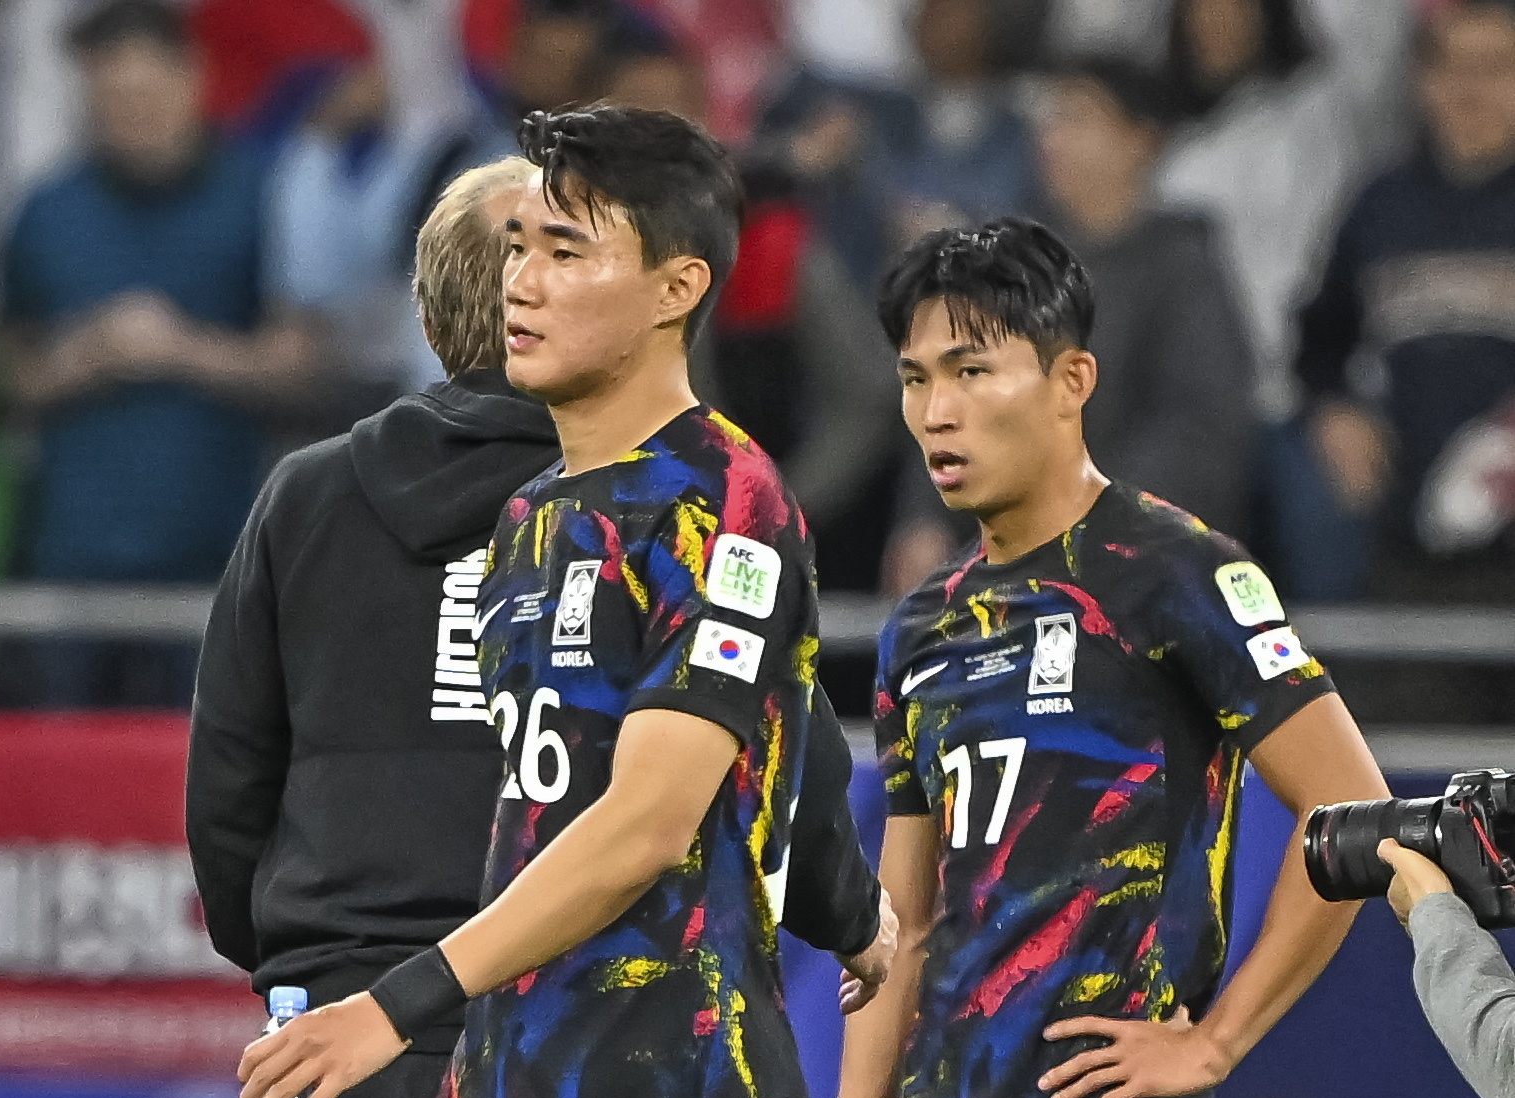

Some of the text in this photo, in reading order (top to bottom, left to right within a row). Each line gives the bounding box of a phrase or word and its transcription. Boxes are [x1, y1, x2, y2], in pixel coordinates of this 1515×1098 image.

[727, 546, 755, 563] AFC
[723, 557, 768, 587] LIVE
[551, 650, 594, 668] KOREA
[1026, 697, 1074, 716] KOREA
[490, 686, 571, 804] 26
[940, 737, 1027, 849] 17
